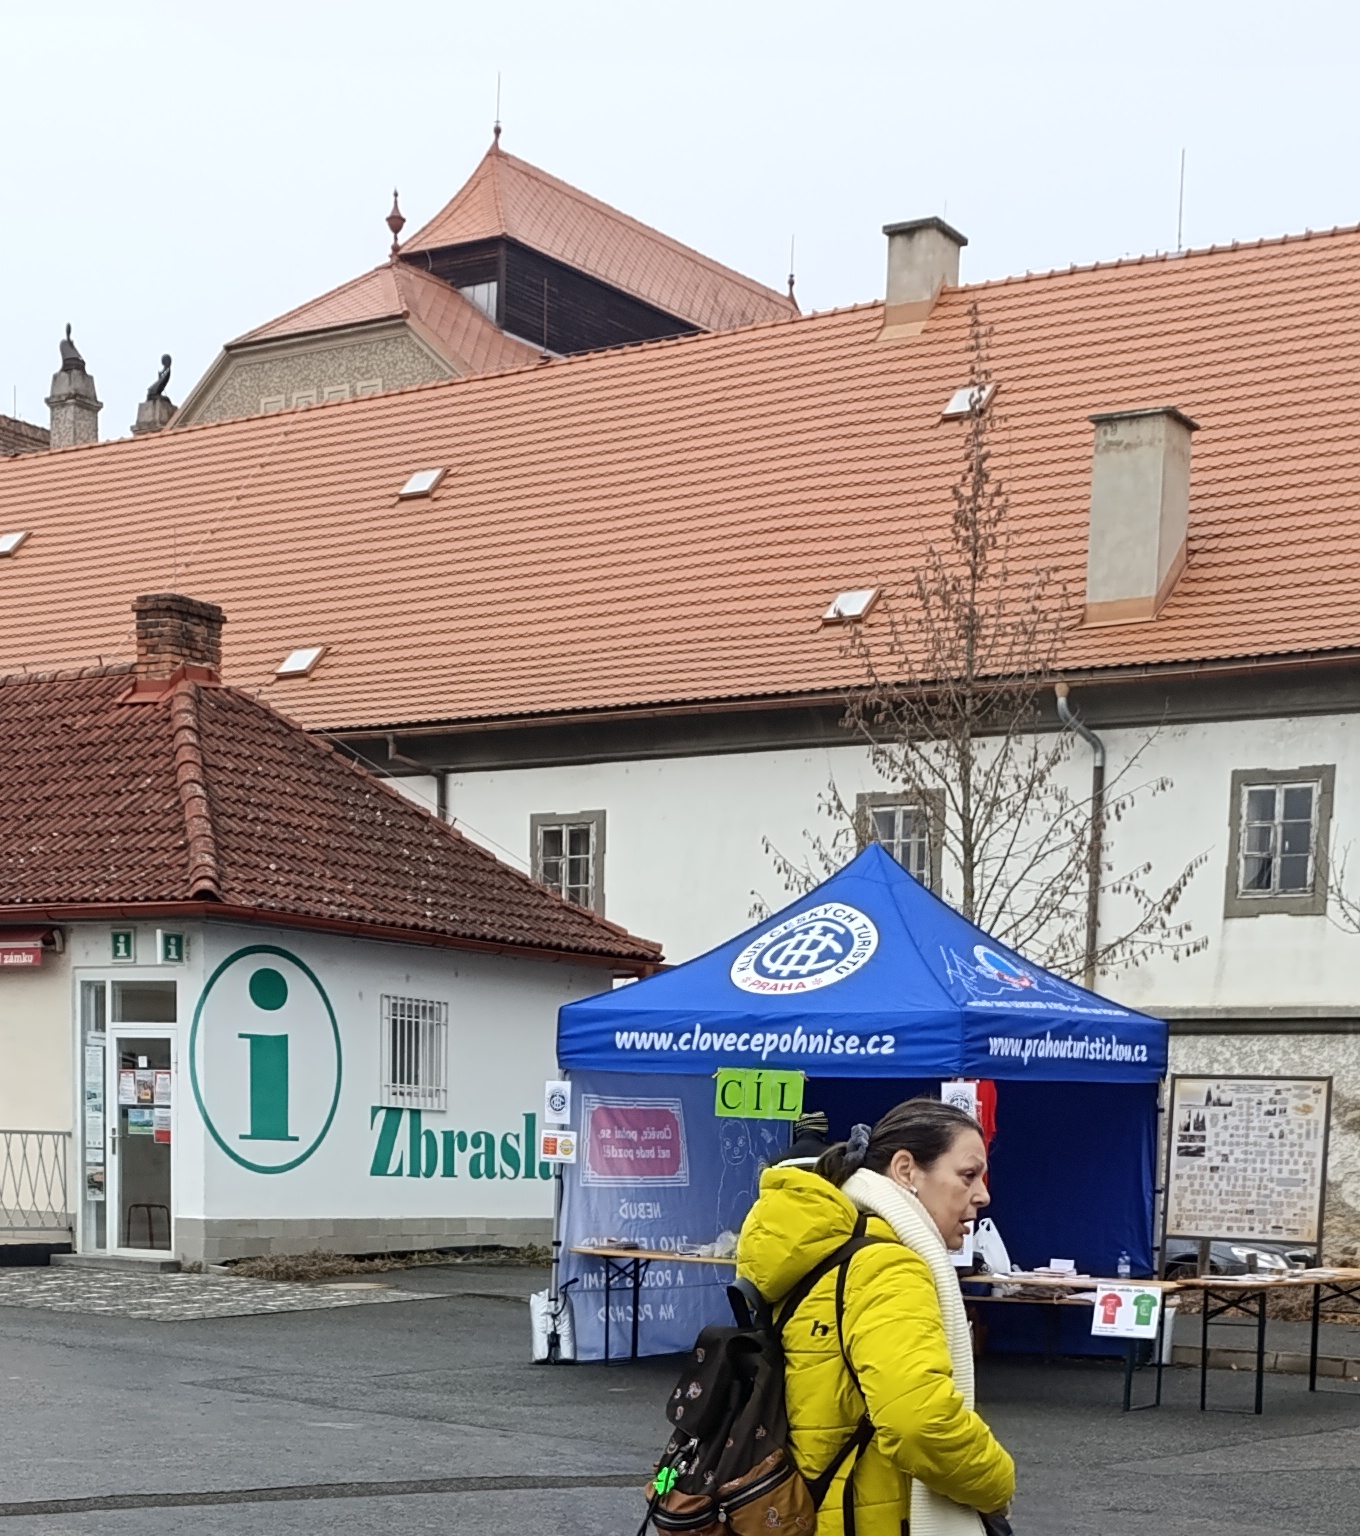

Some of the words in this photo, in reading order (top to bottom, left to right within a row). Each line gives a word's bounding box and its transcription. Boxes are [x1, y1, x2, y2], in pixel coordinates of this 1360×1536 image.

[3, 951, 34, 965] zámku
[736, 942, 766, 973] KLUB
[748, 979, 807, 992] PRAHA
[615, 1023, 896, 1061] www.clovecepohnise.cz
[988, 1030, 1148, 1066] www.prahouturistickou.cz
[720, 1072, 799, 1112] CÍL
